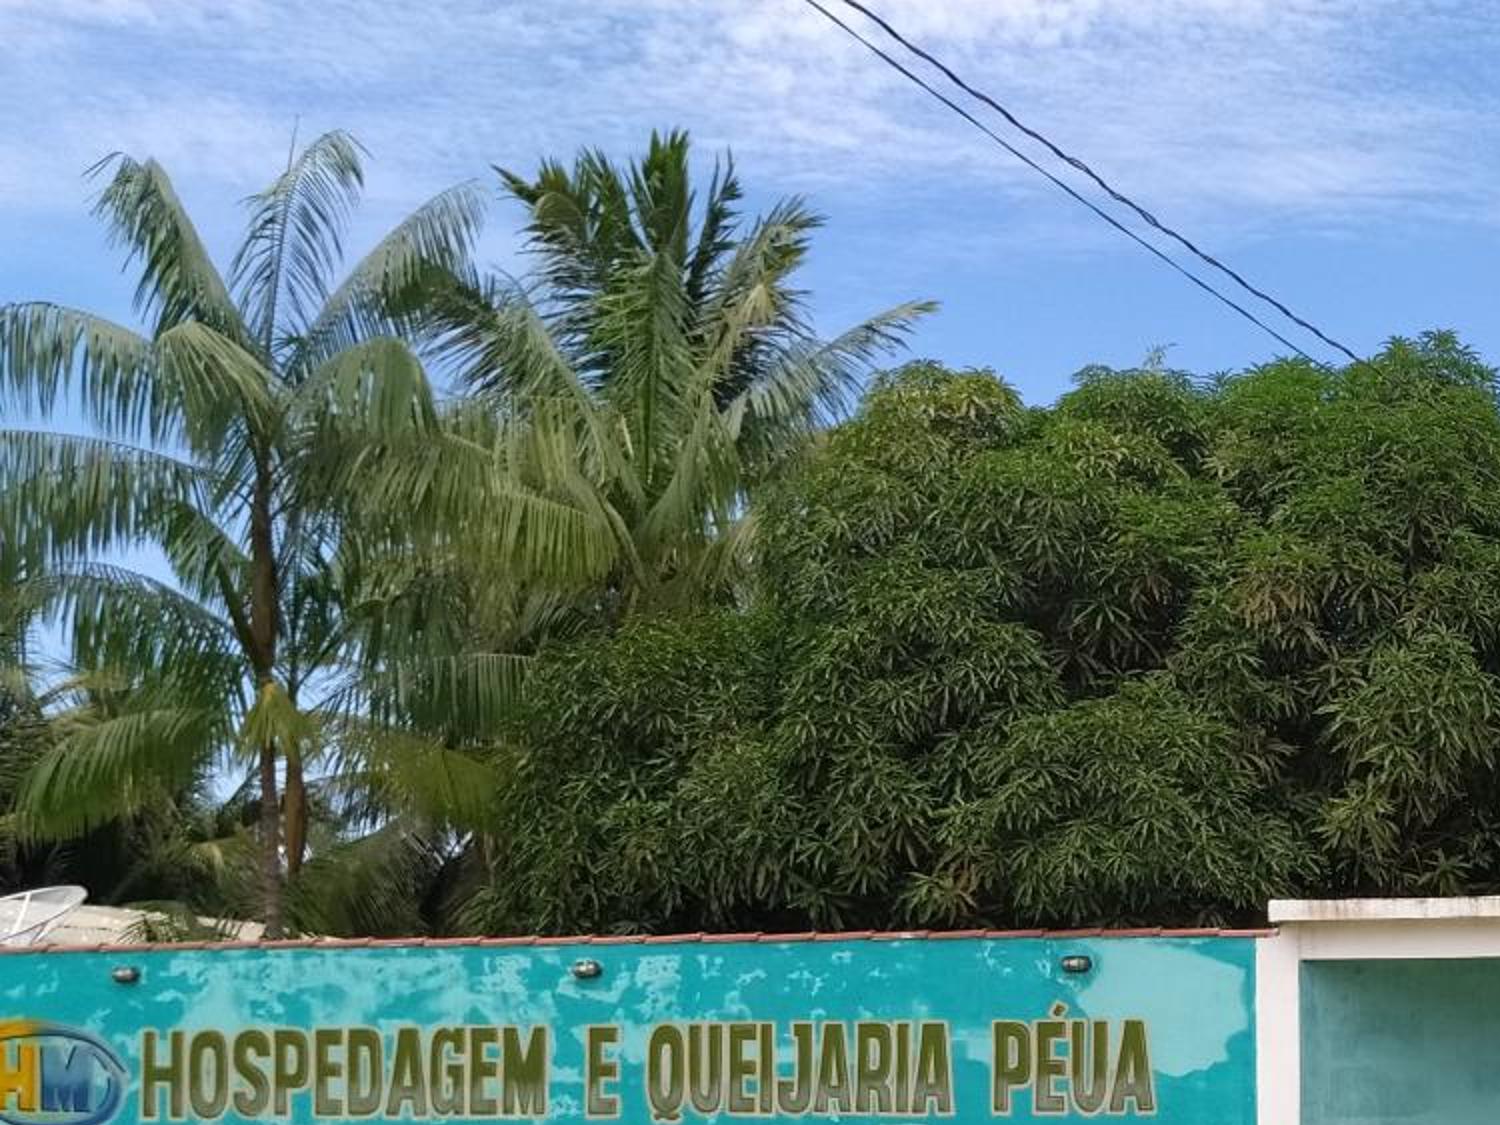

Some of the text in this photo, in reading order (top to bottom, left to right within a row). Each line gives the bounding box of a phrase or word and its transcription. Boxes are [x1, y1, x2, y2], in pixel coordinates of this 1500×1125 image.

[140, 1001, 1156, 1124] HOSPEDAGEM E QUEIJARIA PÉUA
